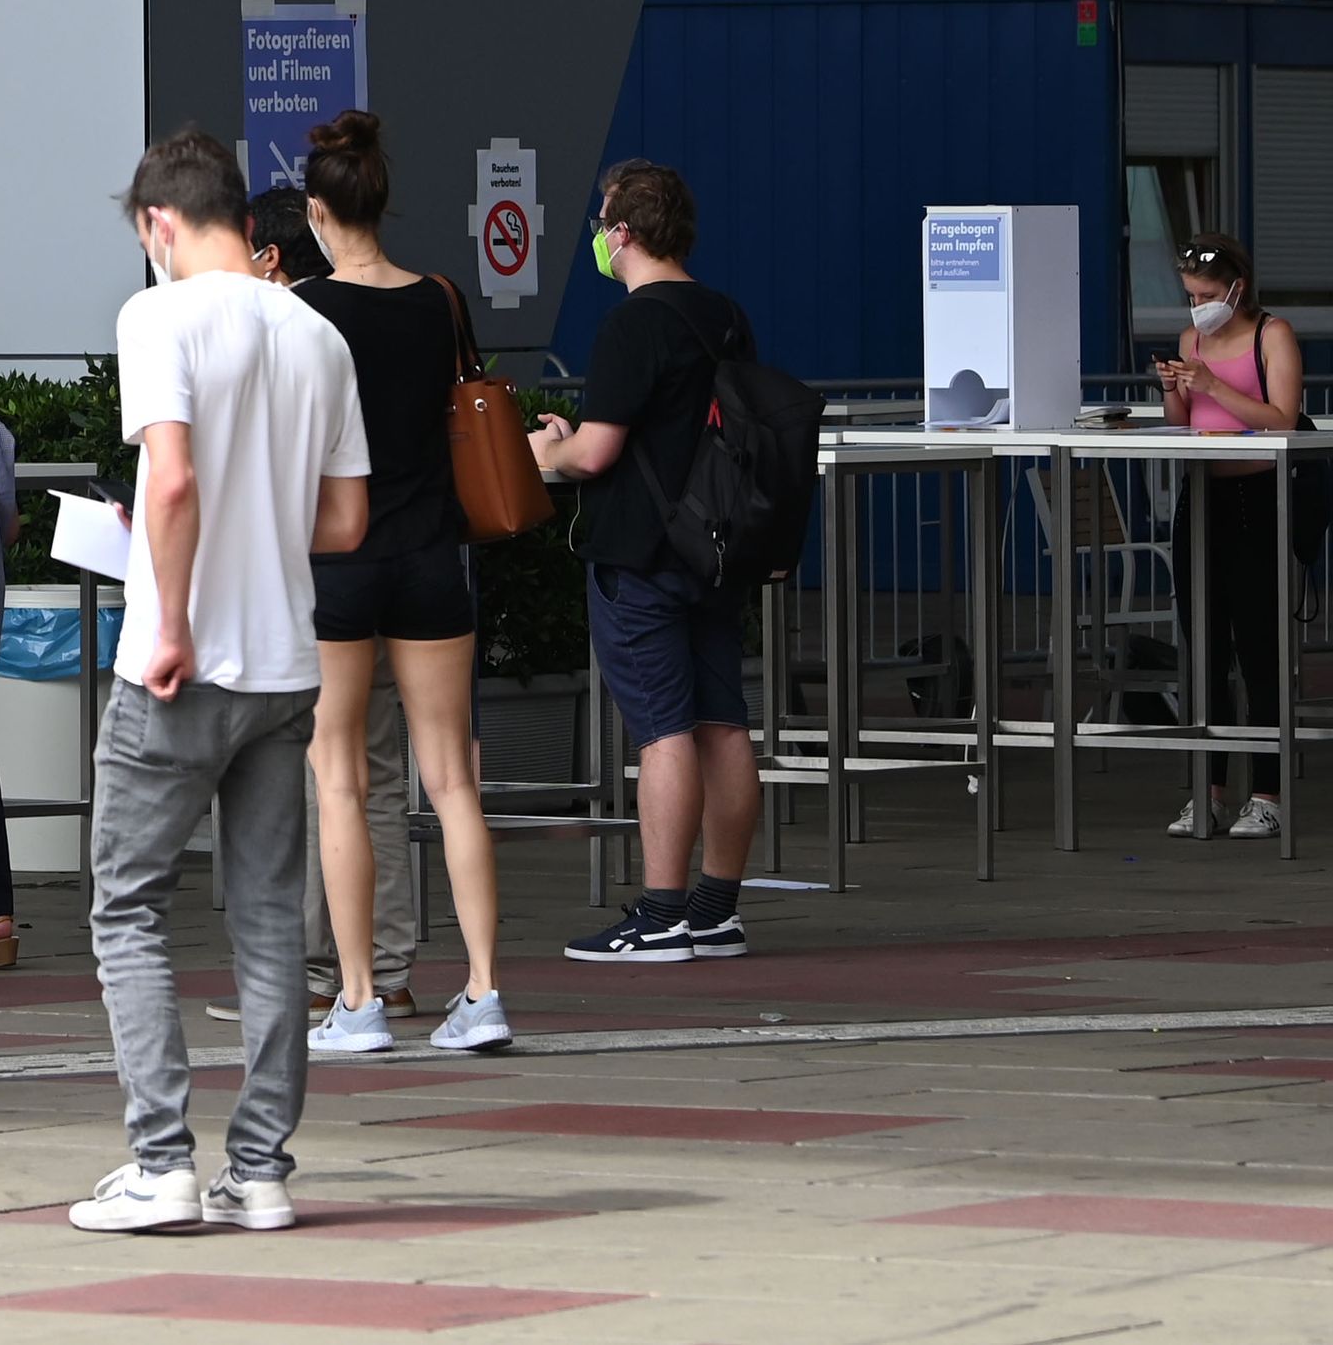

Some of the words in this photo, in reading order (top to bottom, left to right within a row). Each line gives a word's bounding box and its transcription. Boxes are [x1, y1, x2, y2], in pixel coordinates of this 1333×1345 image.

[247, 27, 351, 56] Fotografieren
[248, 59, 278, 81] und
[281, 59, 331, 81] Filmen
[248, 91, 318, 113] verboten
[491, 163, 520, 173] Rauchen
[490, 176, 522, 188] verboten!
[930, 222, 995, 238] Fragebogen
[930, 242, 953, 252] zum
[955, 239, 994, 255] Impfen
[930, 259, 945, 267] bitte
[930, 268, 943, 277] und
